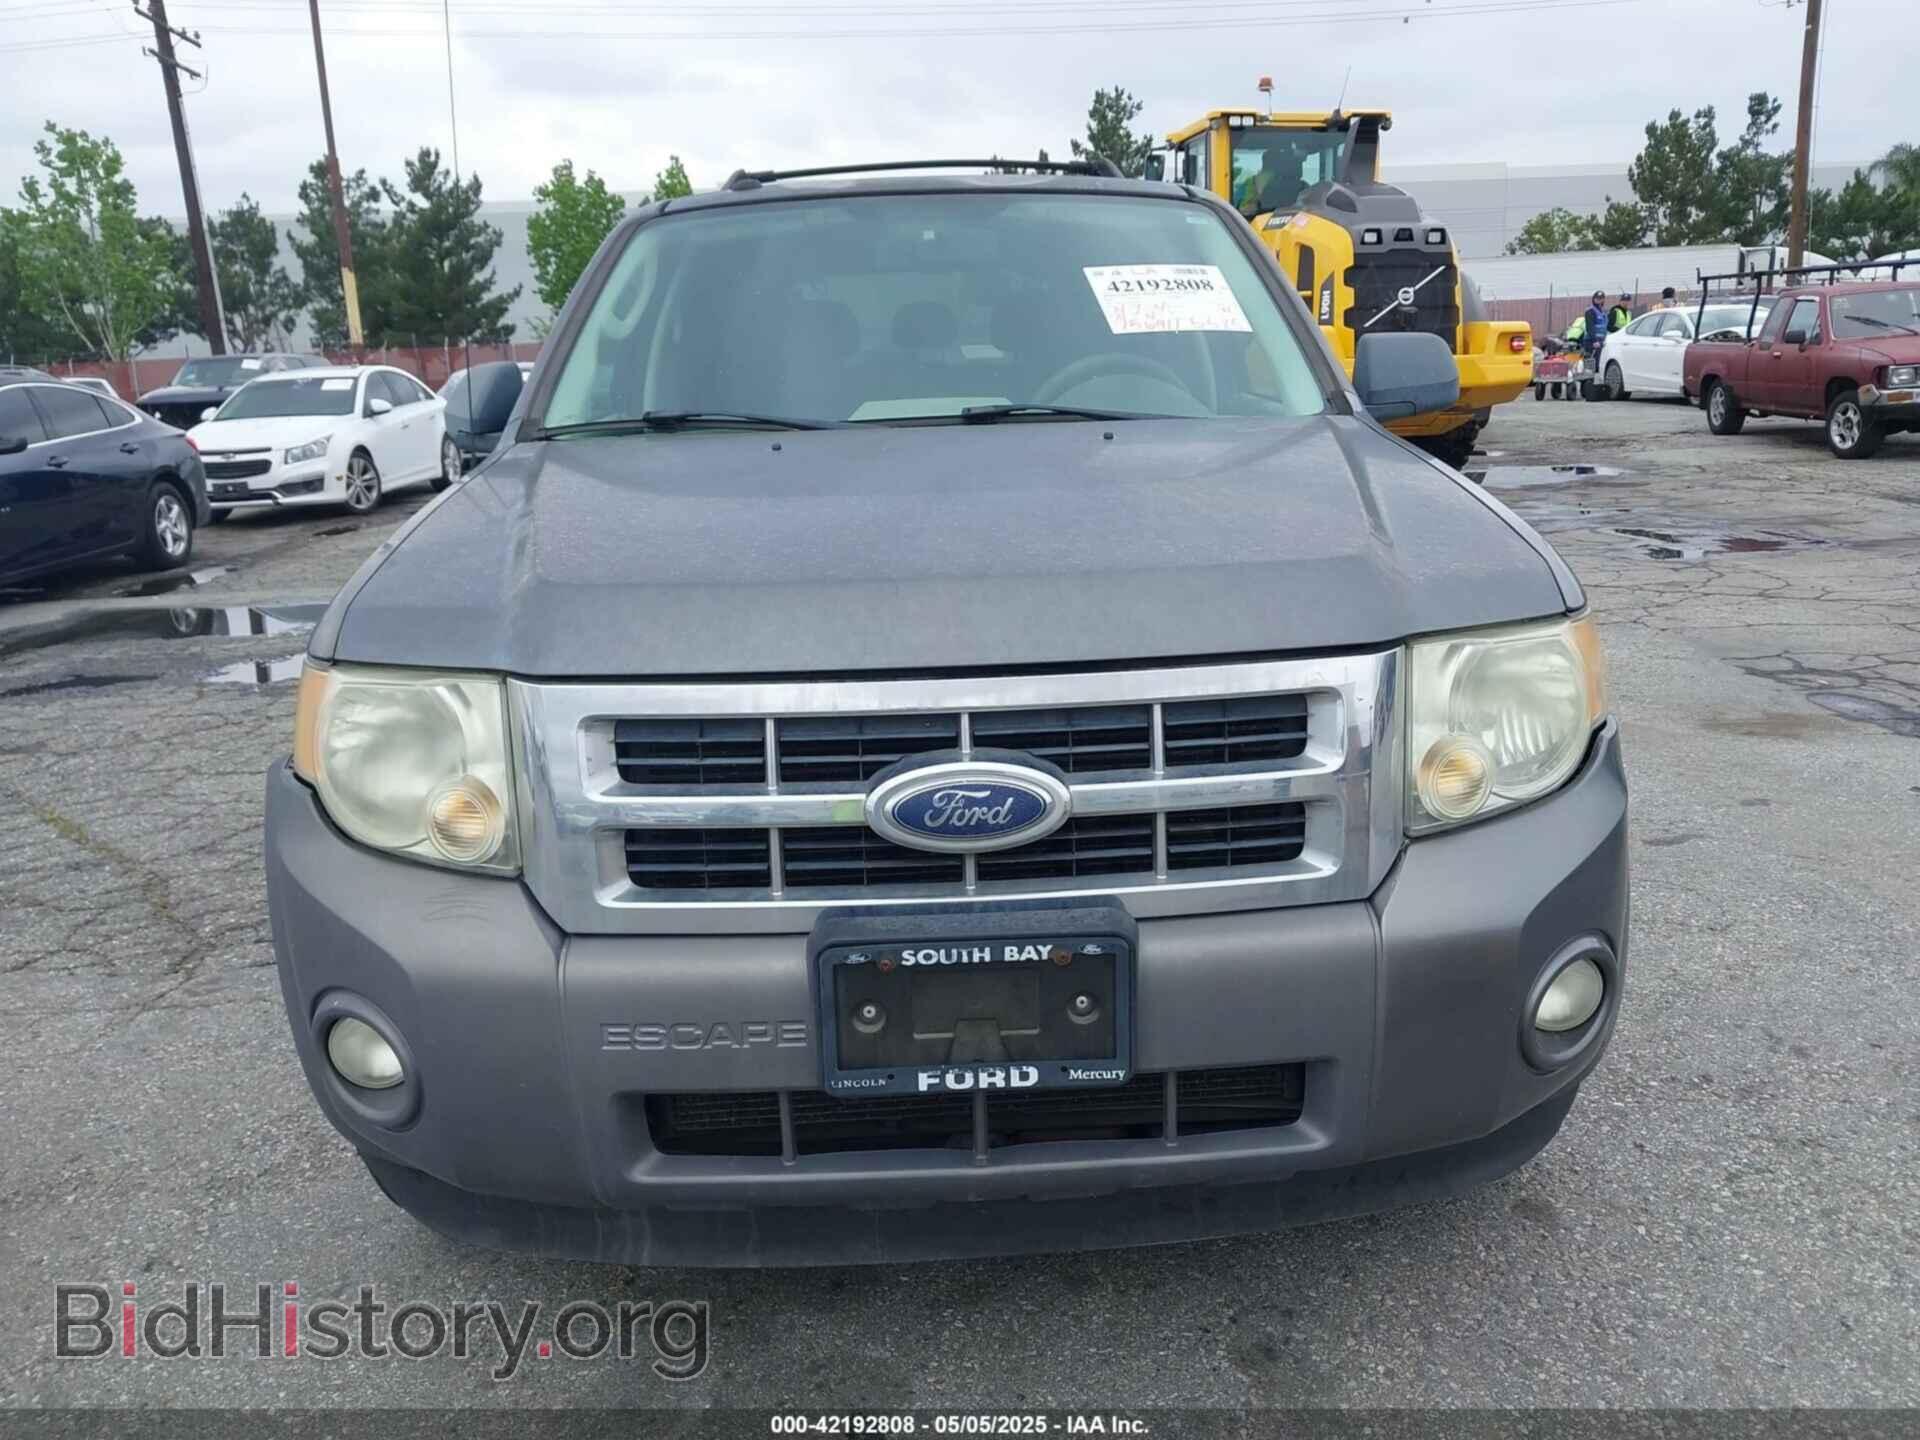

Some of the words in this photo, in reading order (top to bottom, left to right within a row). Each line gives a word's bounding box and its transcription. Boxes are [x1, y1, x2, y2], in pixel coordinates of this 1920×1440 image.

[1107, 279, 1214, 292] 42192808
[923, 789, 1014, 828] Ford
[901, 947, 991, 966] SOUTH
[1004, 944, 1053, 961] BAY
[600, 1020, 808, 1050] ESCAPE
[831, 1079, 886, 1088] LINCOLN
[917, 1066, 1039, 1091] FORD
[1068, 1068, 1126, 1084] Mercury
